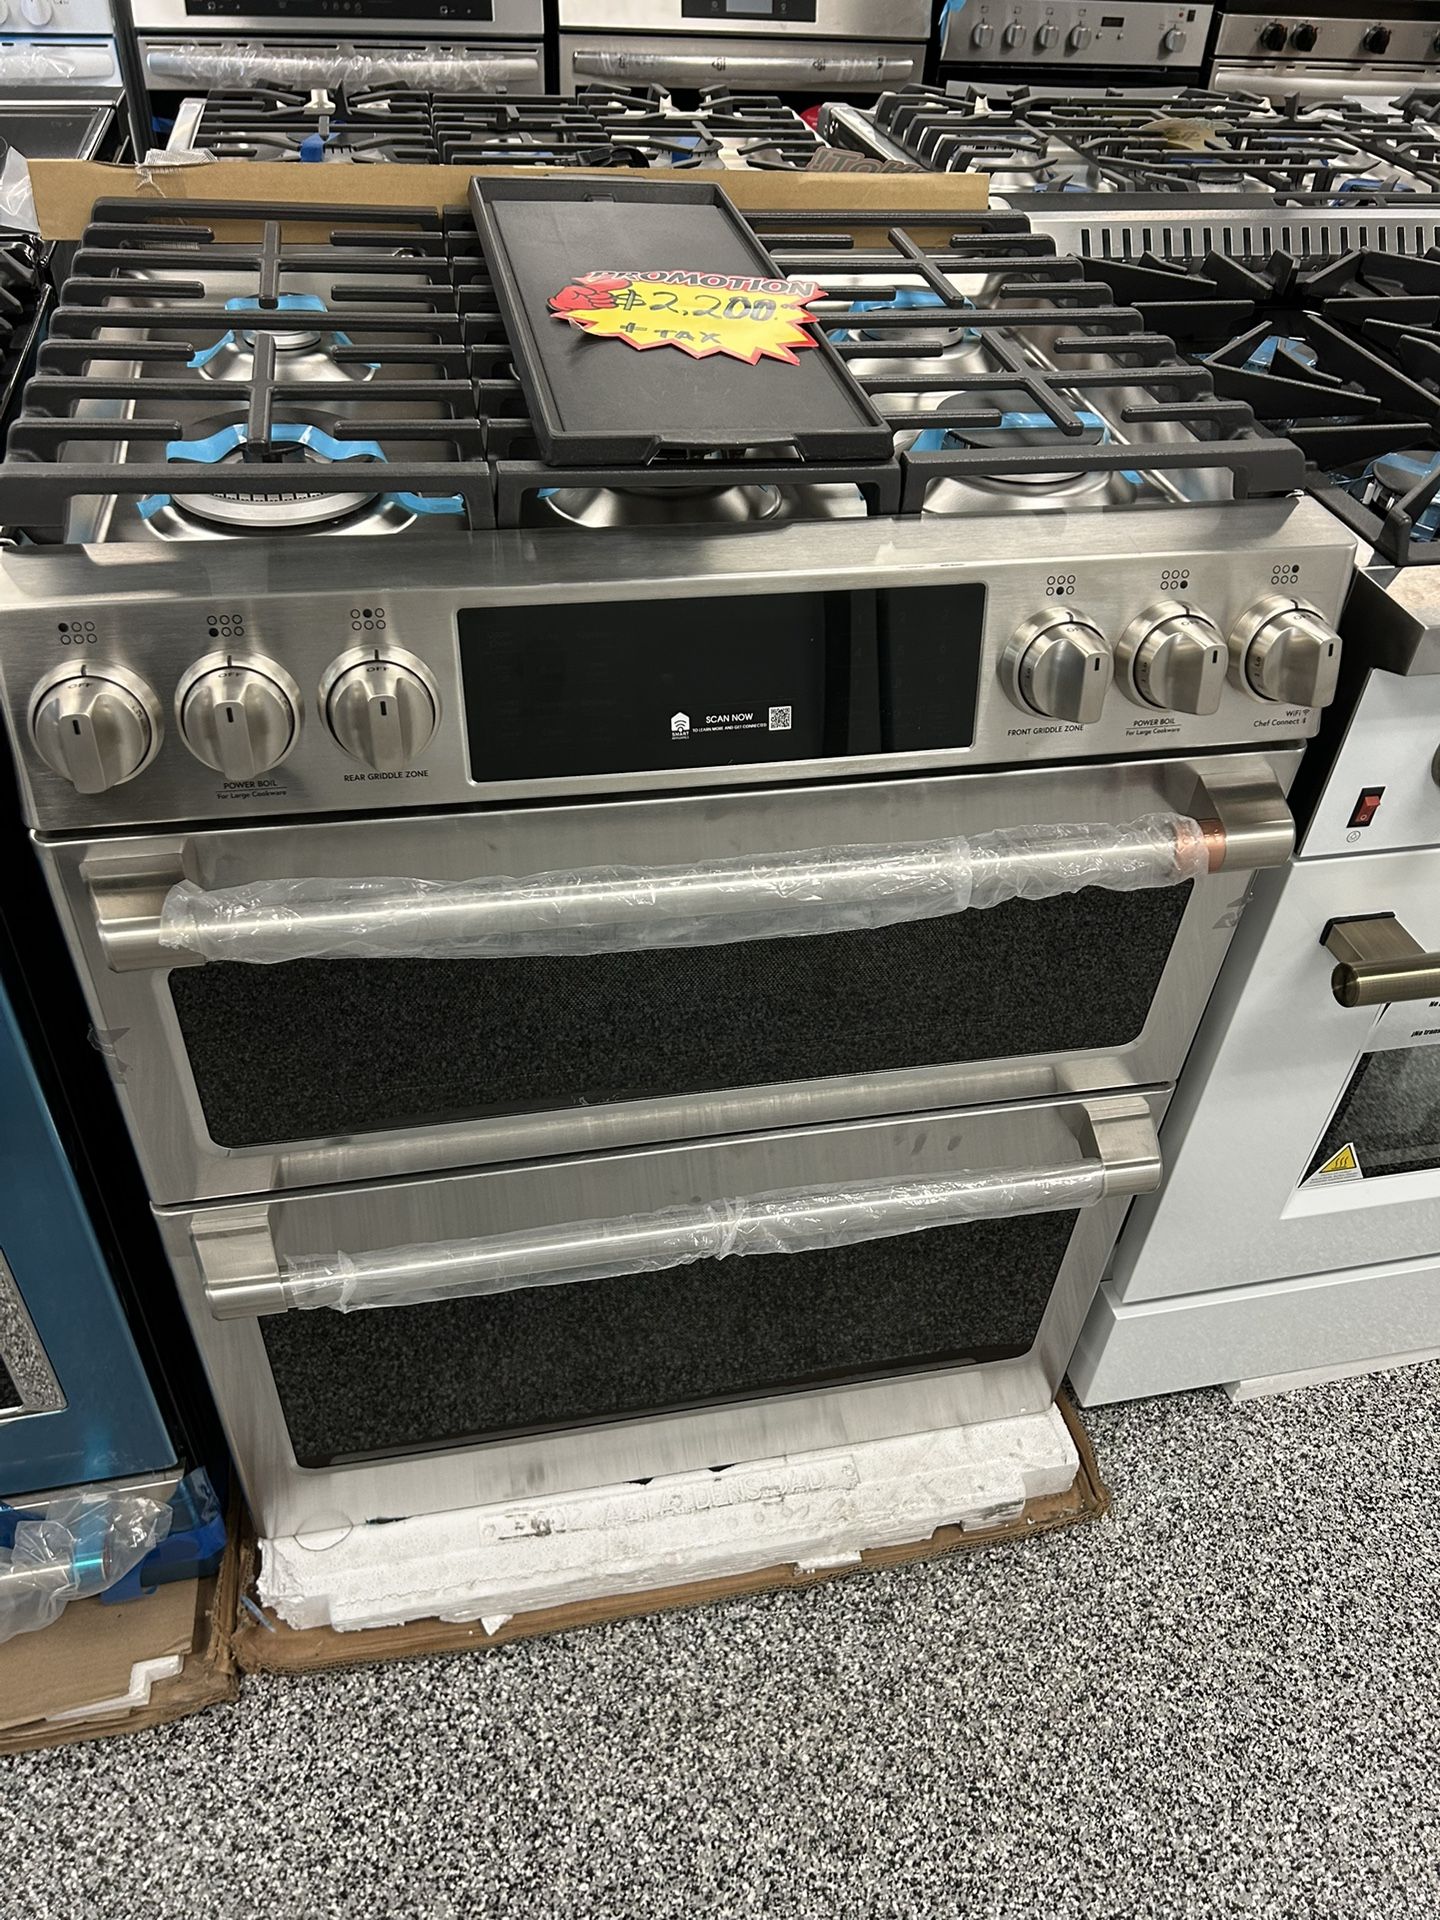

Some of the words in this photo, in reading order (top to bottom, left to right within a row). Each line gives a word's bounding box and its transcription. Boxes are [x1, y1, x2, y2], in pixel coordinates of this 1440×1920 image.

[654, 329, 721, 343] TAX
[705, 714, 730, 723] SCAN
[731, 713, 754, 721] NOW
[1286, 709, 1301, 717] WiFi
[1133, 719, 1159, 727] POWER
[1253, 719, 1270, 728] Chef
[1271, 718, 1300, 727] Connect
[1007, 728, 1031, 736] FRONT
[1032, 725, 1063, 735] GRIDDLE
[1064, 724, 1084, 732] ZONE
[343, 774, 366, 783] REAR
[367, 771, 403, 782] GRIDDLE
[404, 769, 430, 779] ZONE
[223, 781, 256, 790] POWER
[257, 779, 279, 788] BOIL
[230, 792, 251, 800] Large
[251, 790, 287, 798] Cookware
